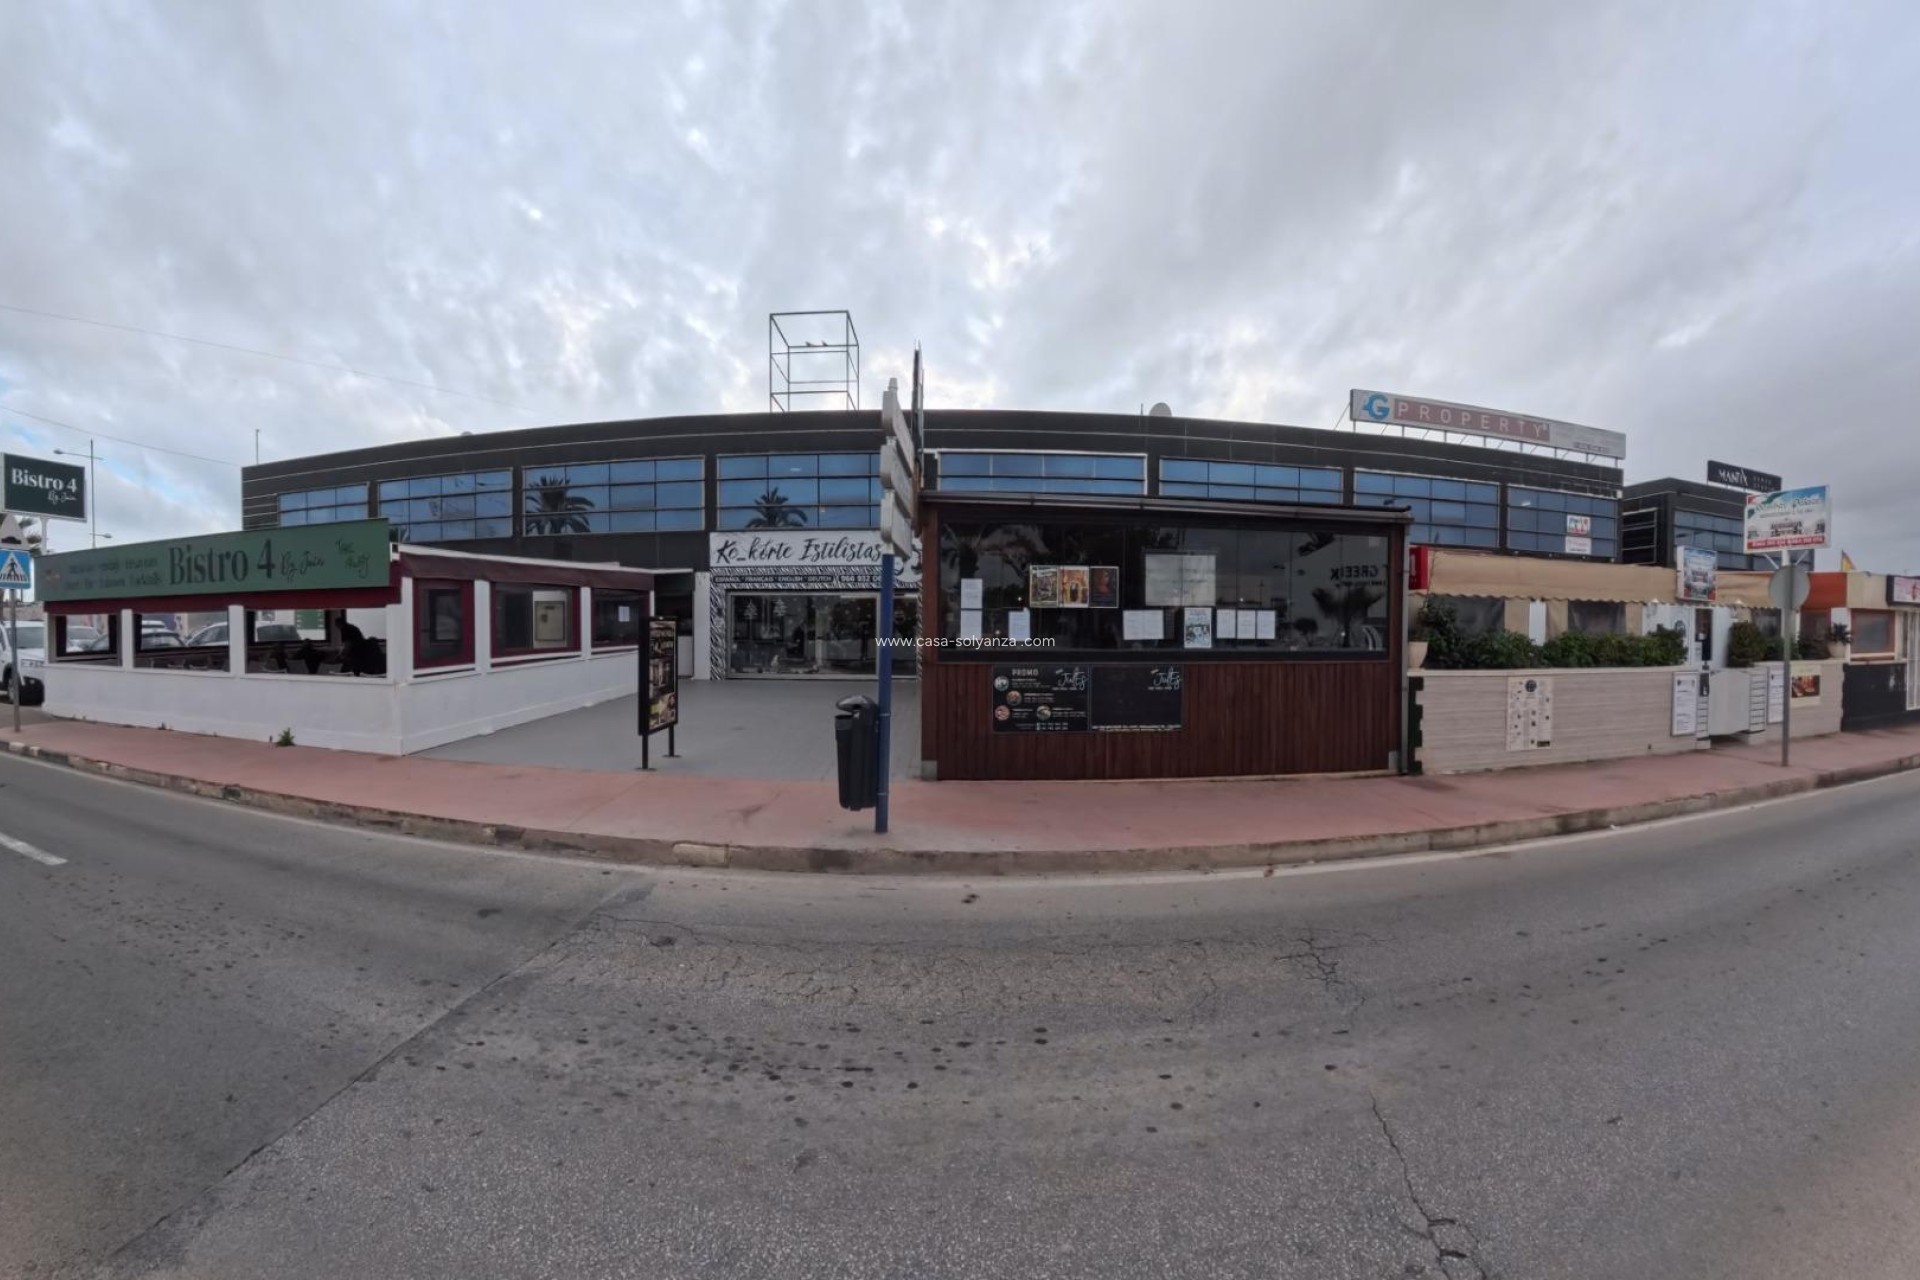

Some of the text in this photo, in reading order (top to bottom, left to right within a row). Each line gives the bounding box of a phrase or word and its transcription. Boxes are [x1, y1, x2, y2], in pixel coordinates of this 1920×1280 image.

[1398, 402, 1541, 438] PROPERTY
[11, 467, 77, 493] Bistro 4
[168, 544, 248, 585] Bistro
[257, 538, 275, 579] 4
[799, 536, 882, 562] Estilistas
